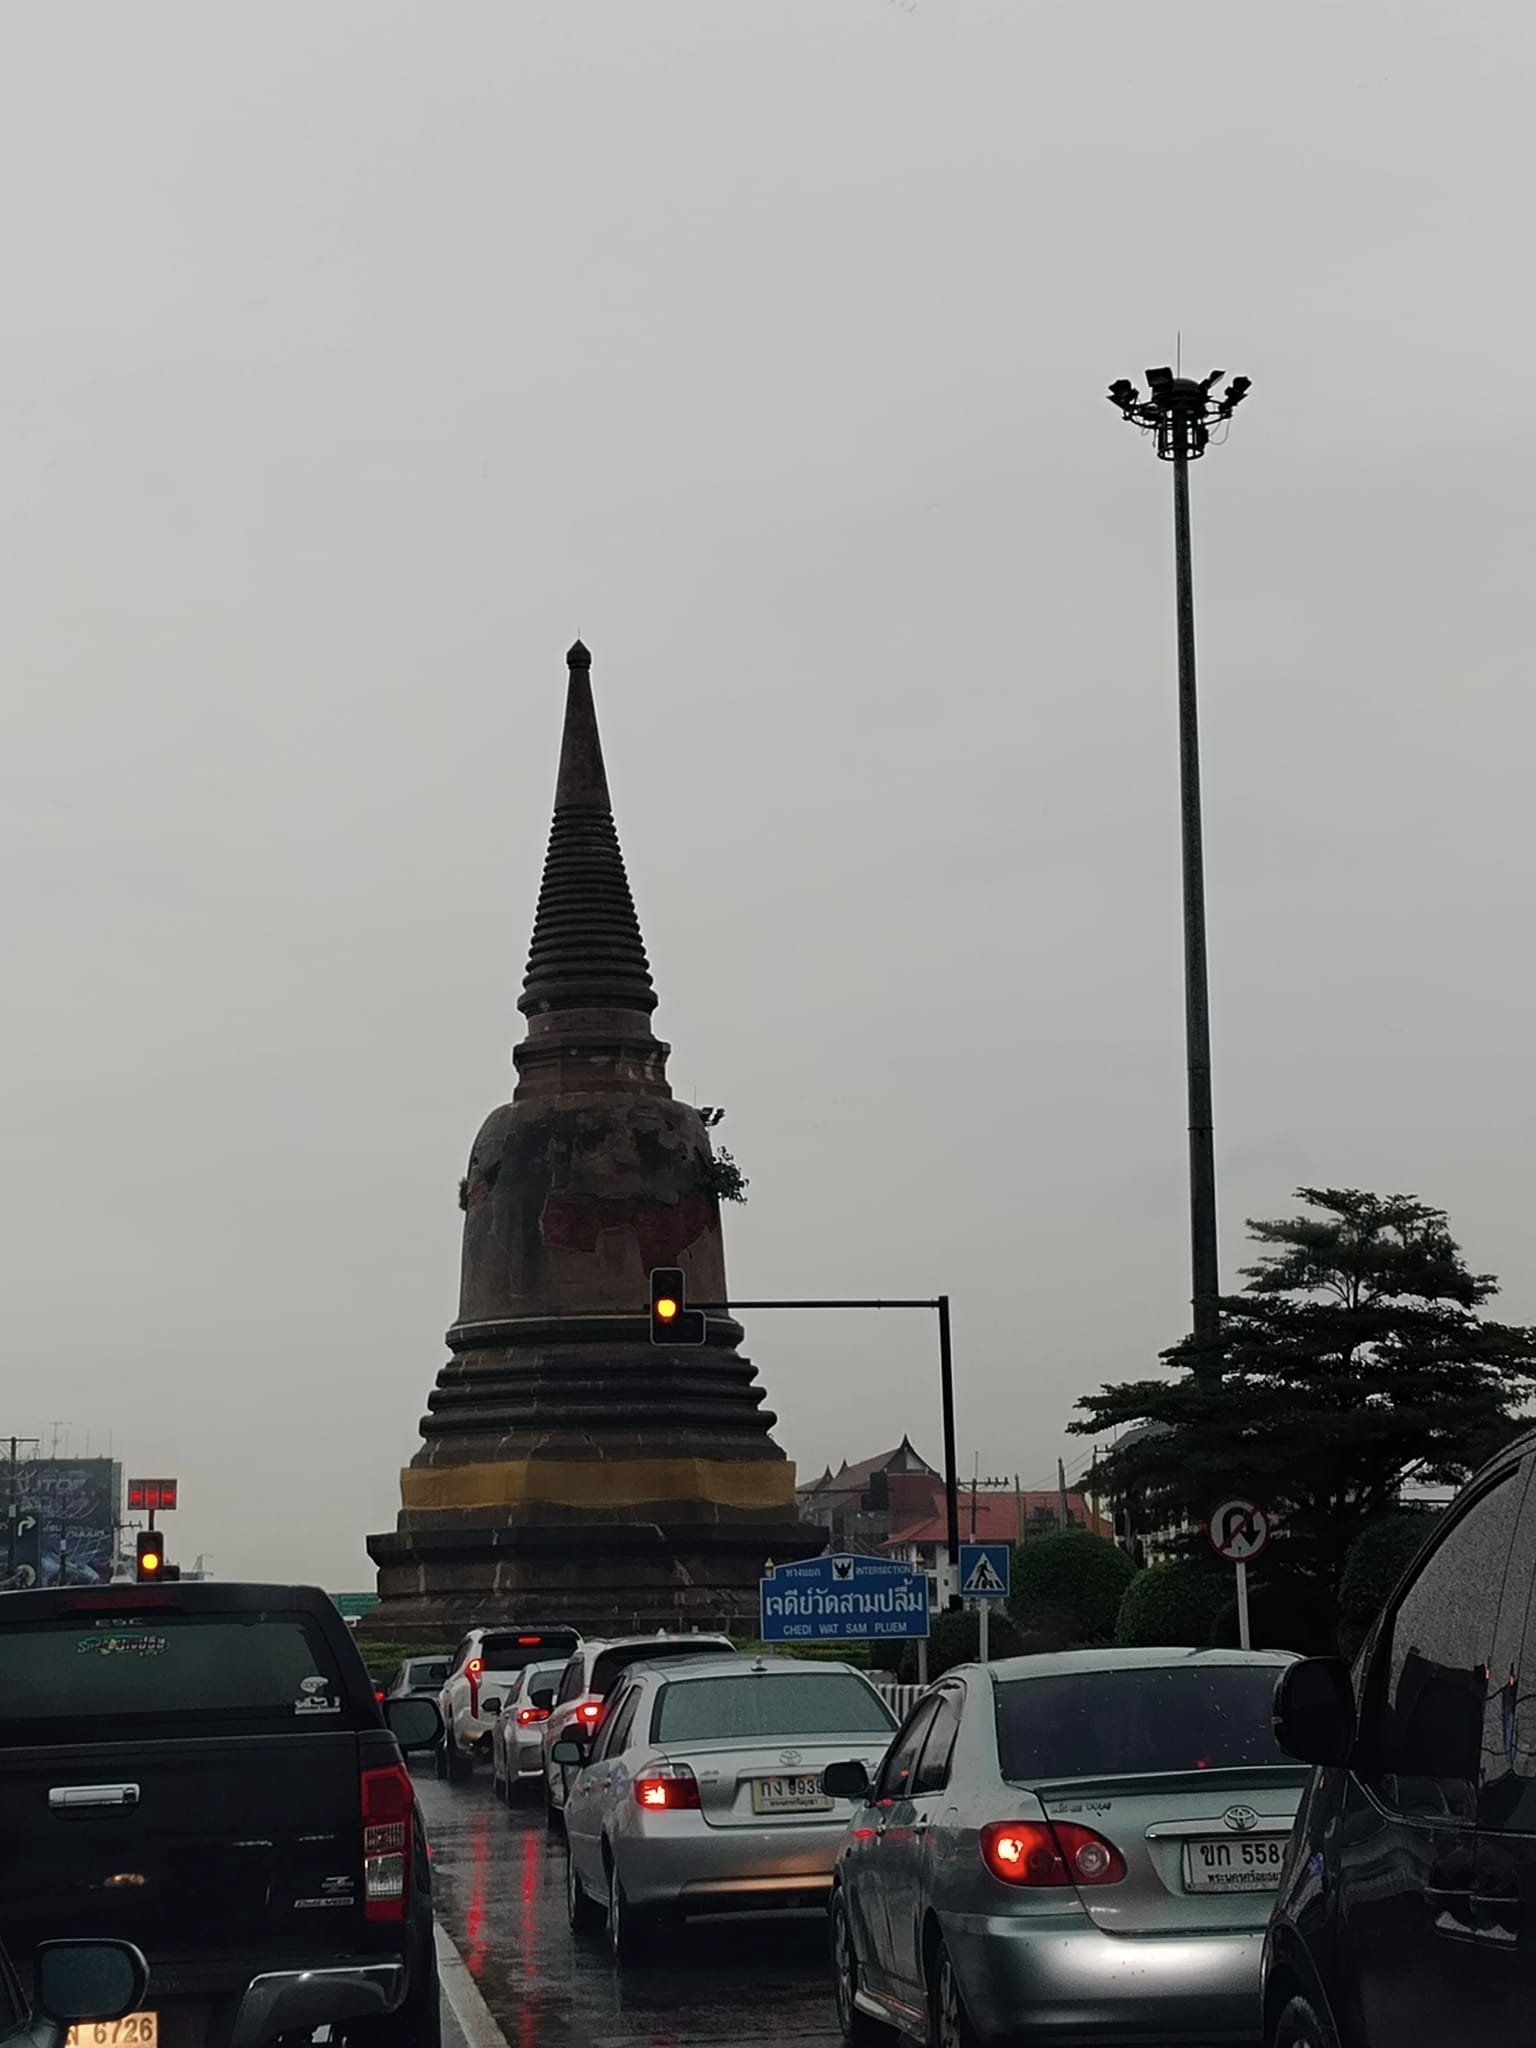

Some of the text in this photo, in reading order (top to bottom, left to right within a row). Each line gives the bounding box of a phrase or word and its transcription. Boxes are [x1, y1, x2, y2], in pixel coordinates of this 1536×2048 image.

[855, 1565, 912, 1576] INTERSECTION
[766, 1577, 923, 1616] เจดีย์วัดสามปลื้ม
[783, 1621, 908, 1636] CHEDI WAT SAM PLUEM
[1200, 1843, 1285, 1866] ขก 558
